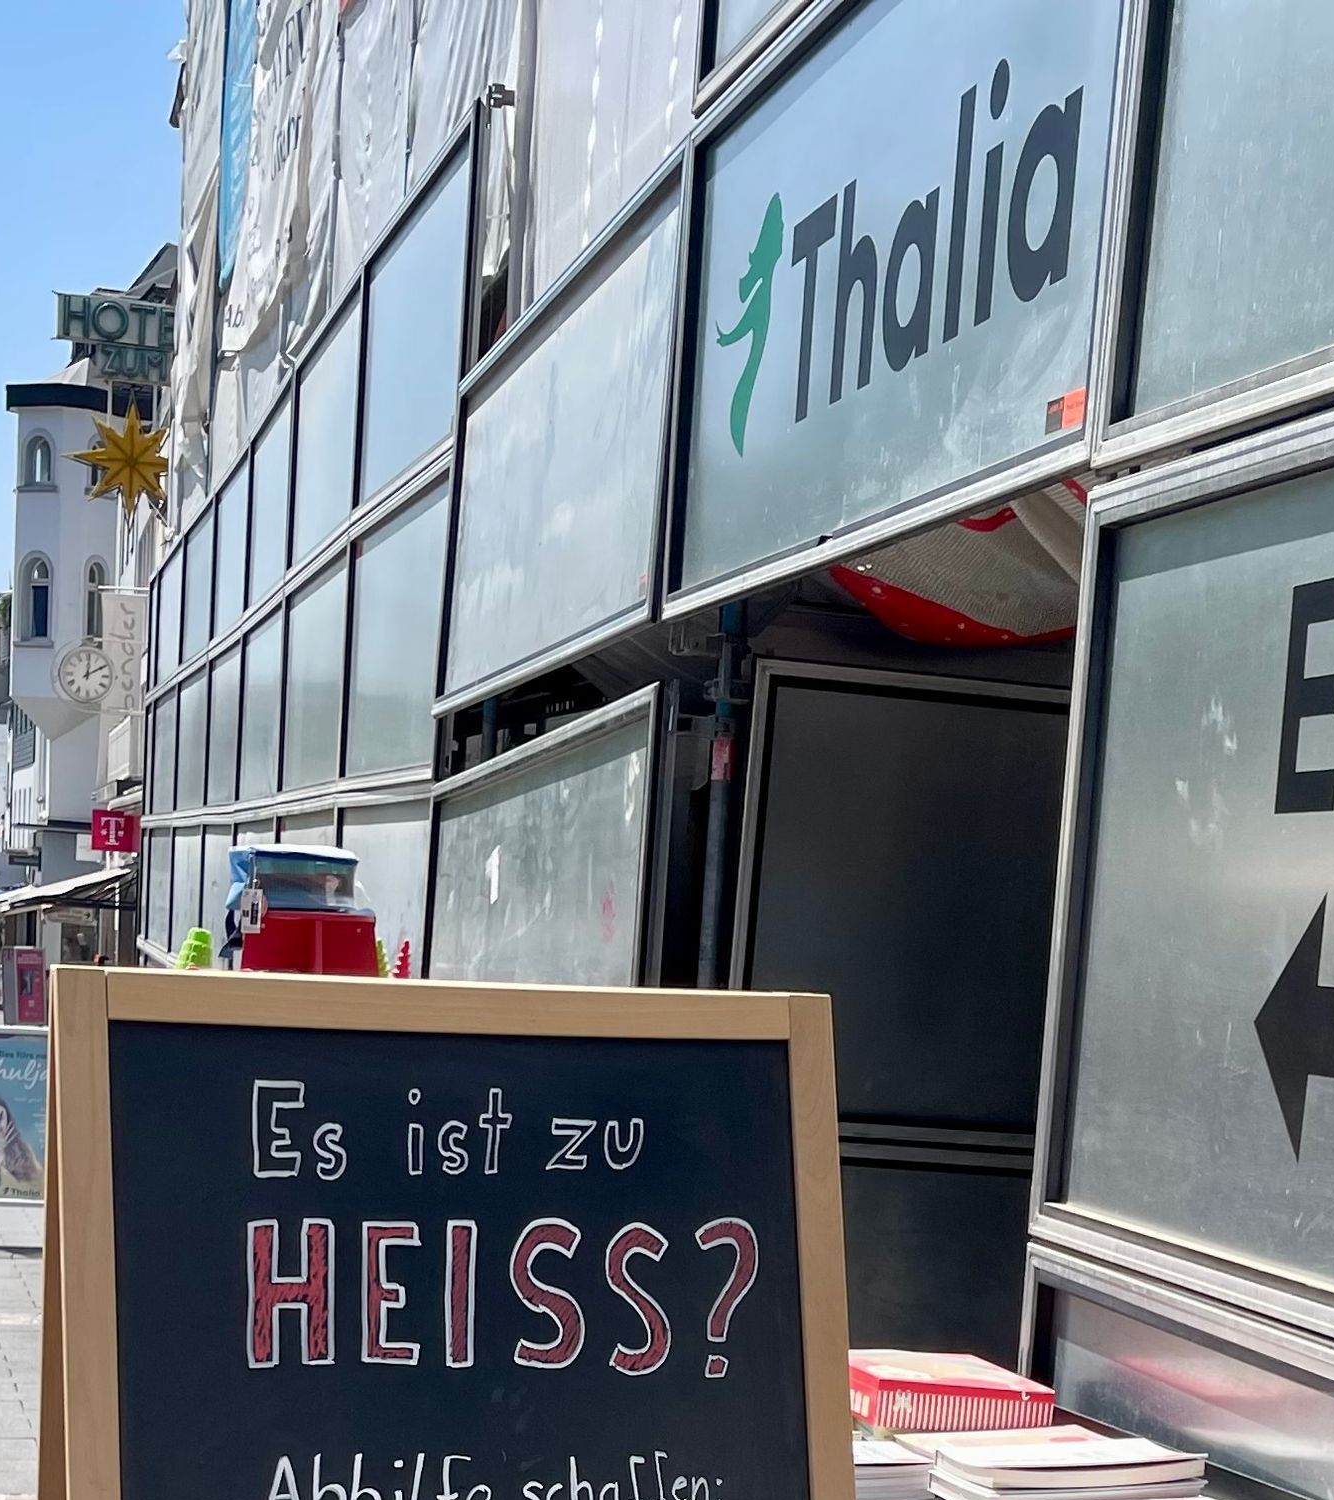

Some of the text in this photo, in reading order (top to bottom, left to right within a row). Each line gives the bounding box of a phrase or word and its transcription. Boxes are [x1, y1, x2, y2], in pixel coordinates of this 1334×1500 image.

[792, 58, 1084, 424] Thalia
[252, 1079, 645, 1181] Es ist zu
[246, 1217, 759, 1378] HEISS?
